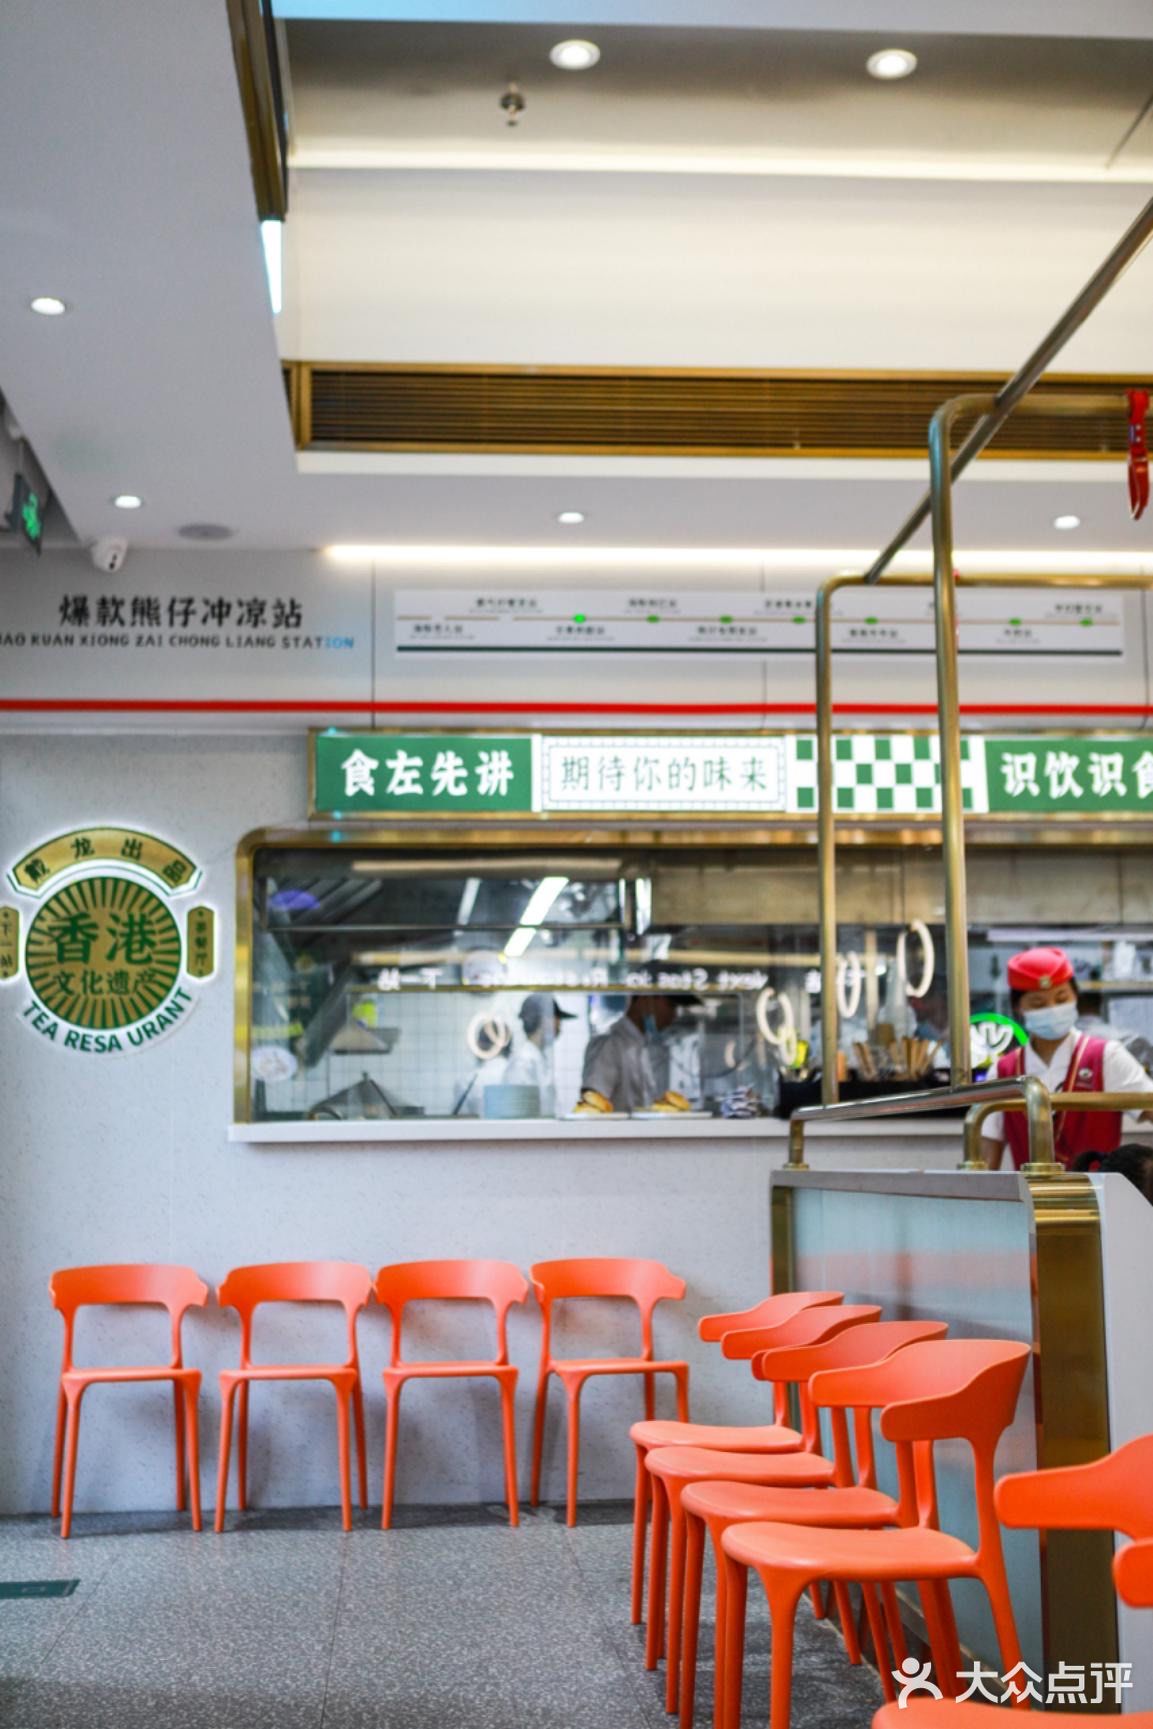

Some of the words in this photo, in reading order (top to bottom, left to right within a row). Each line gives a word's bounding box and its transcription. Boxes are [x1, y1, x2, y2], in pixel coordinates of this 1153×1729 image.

[59, 594, 303, 629] 爆款熊仔冲凉站
[0, 633, 26, 647] AO
[31, 633, 75, 647] KUAN
[80, 634, 130, 648] XIONG
[135, 634, 163, 648] ZAI
[169, 634, 220, 649] CHONG
[225, 635, 276, 649] LIANG
[282, 636, 354, 649] STATION
[340, 749, 515, 797] 食左先讲
[560, 754, 768, 793] 期待你的味来
[48, 911, 158, 965] 香港
[23, 1000, 58, 1041] TEA
[64, 1029, 123, 1053] RESA
[127, 987, 192, 1047] URANT
